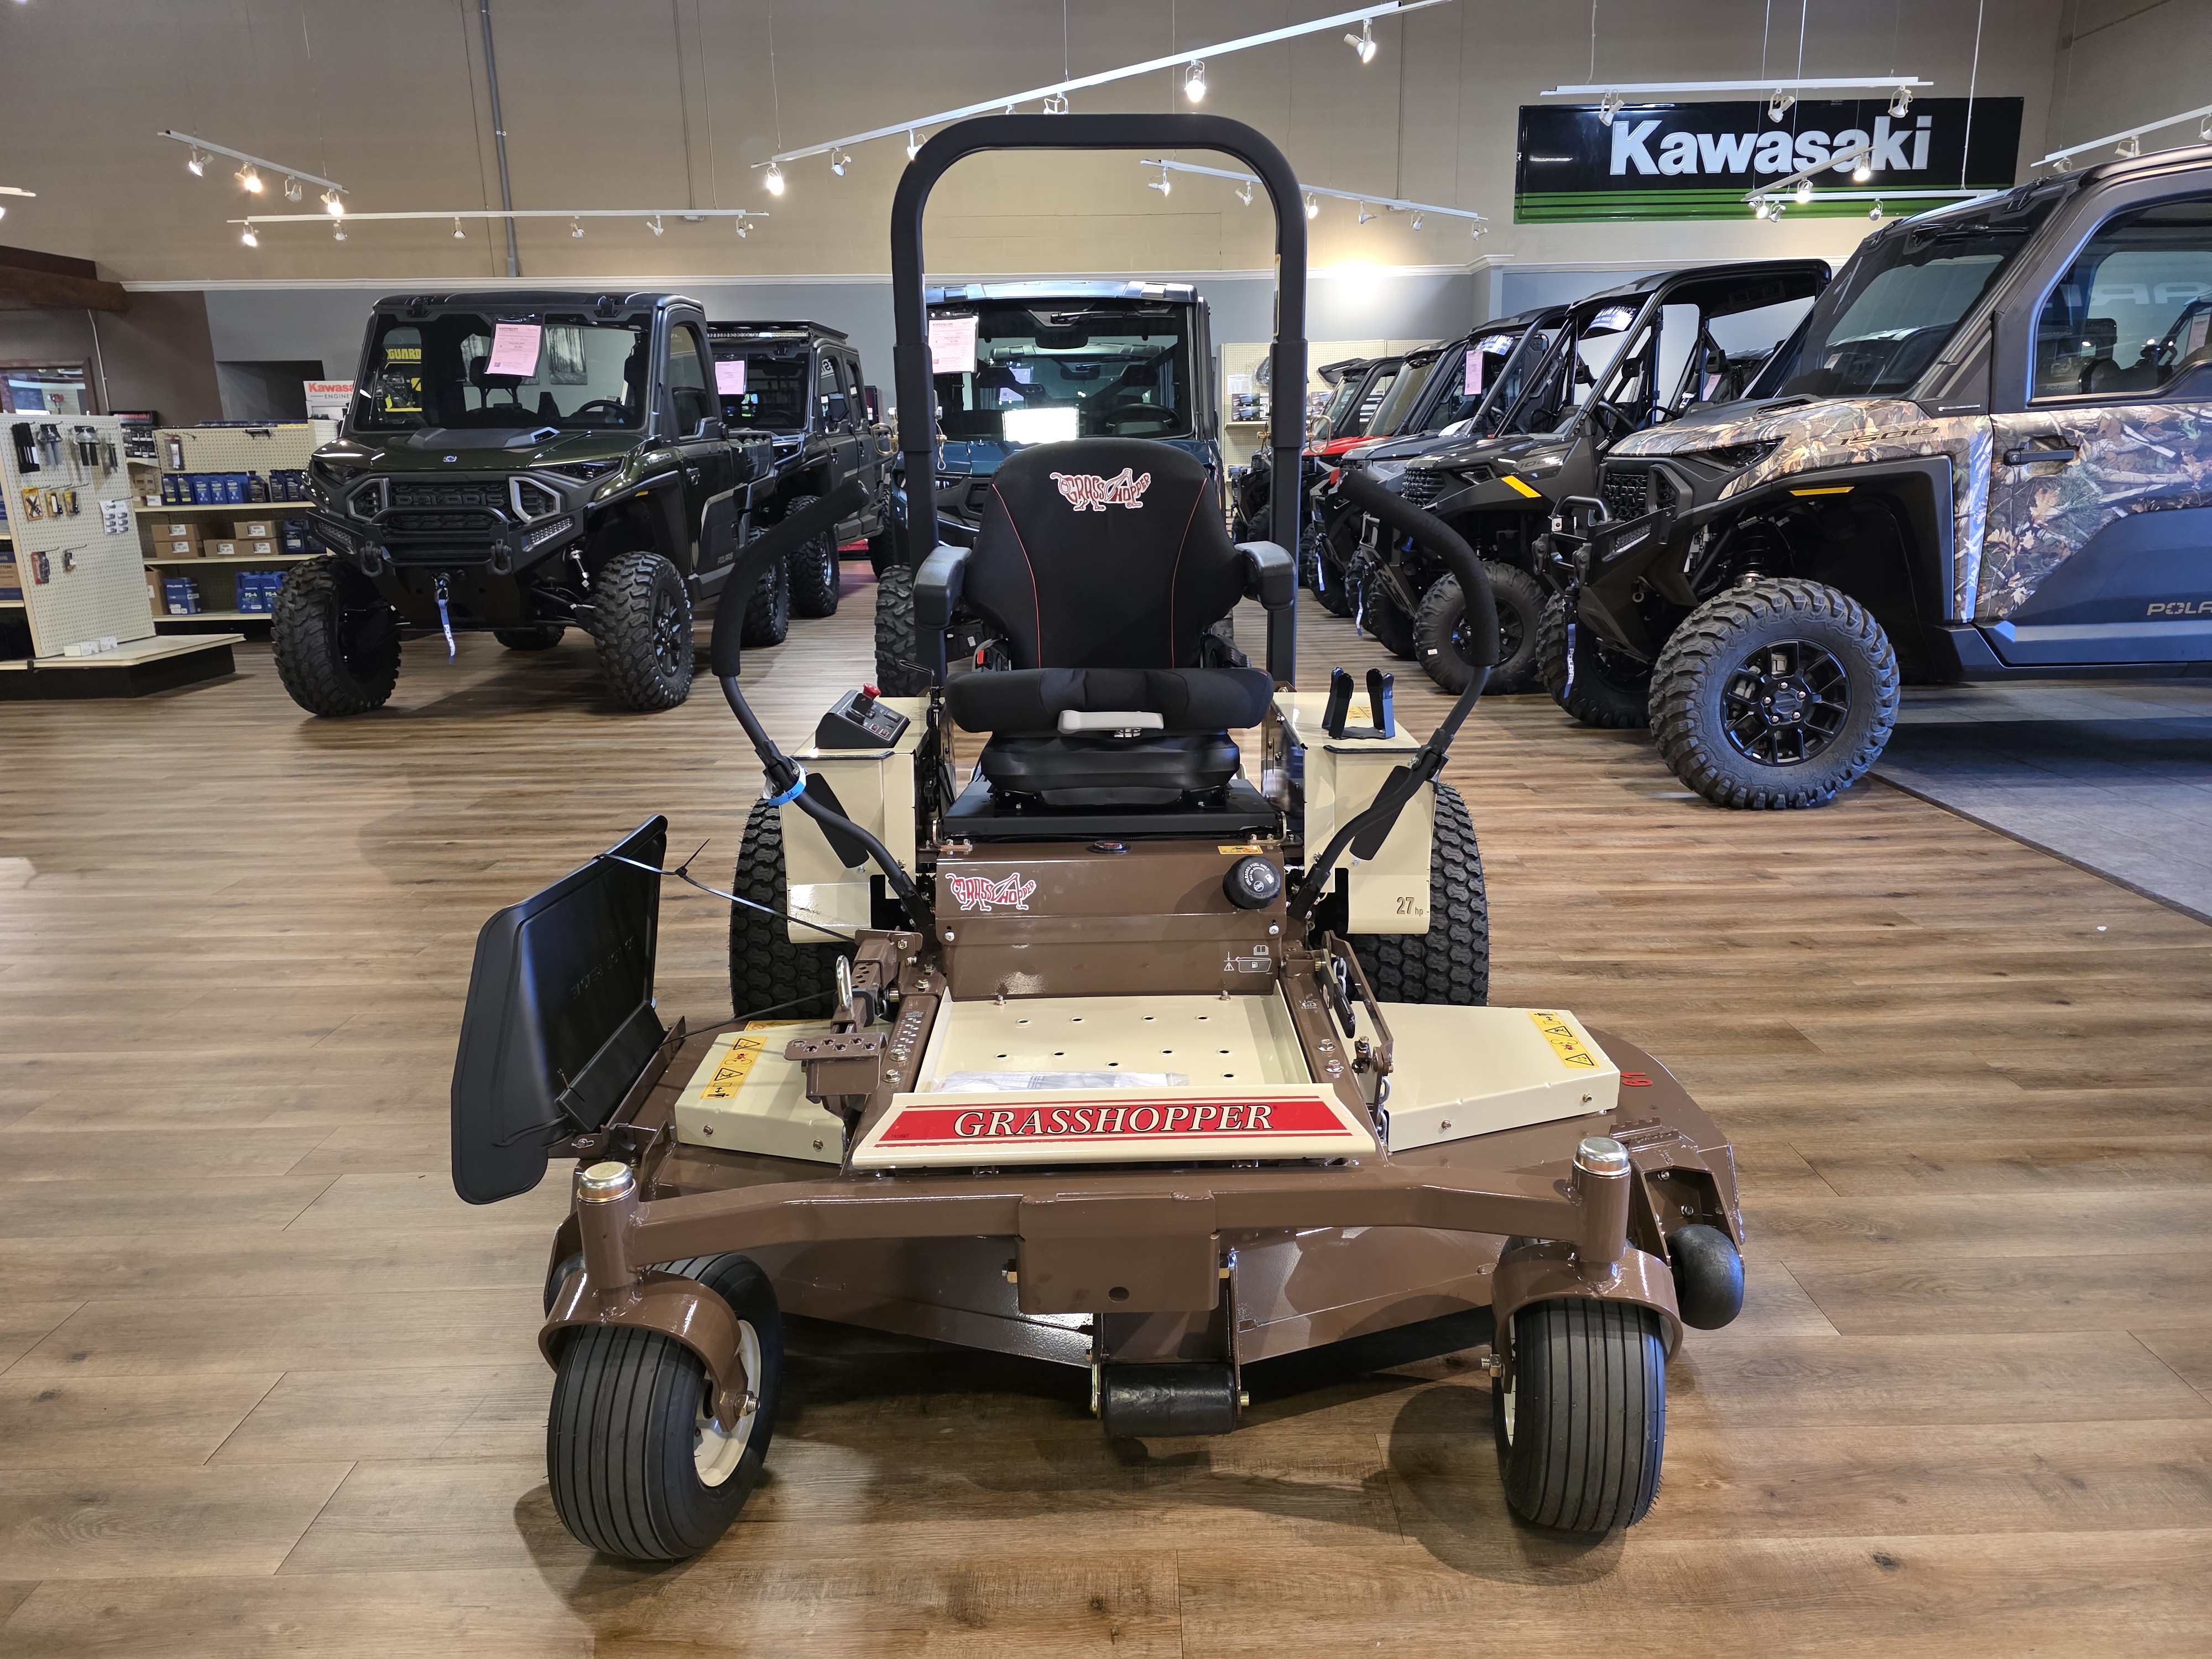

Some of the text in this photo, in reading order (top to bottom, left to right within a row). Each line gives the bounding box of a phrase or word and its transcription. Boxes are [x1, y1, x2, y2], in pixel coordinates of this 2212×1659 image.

[1610, 116, 1932, 175] Kawasaki
[386, 348, 421, 359] GUARD
[1840, 427, 1939, 446] 1500
[1396, 896, 1423, 917] 27 hp
[953, 1105, 1274, 1137] GRASSHOPPER
